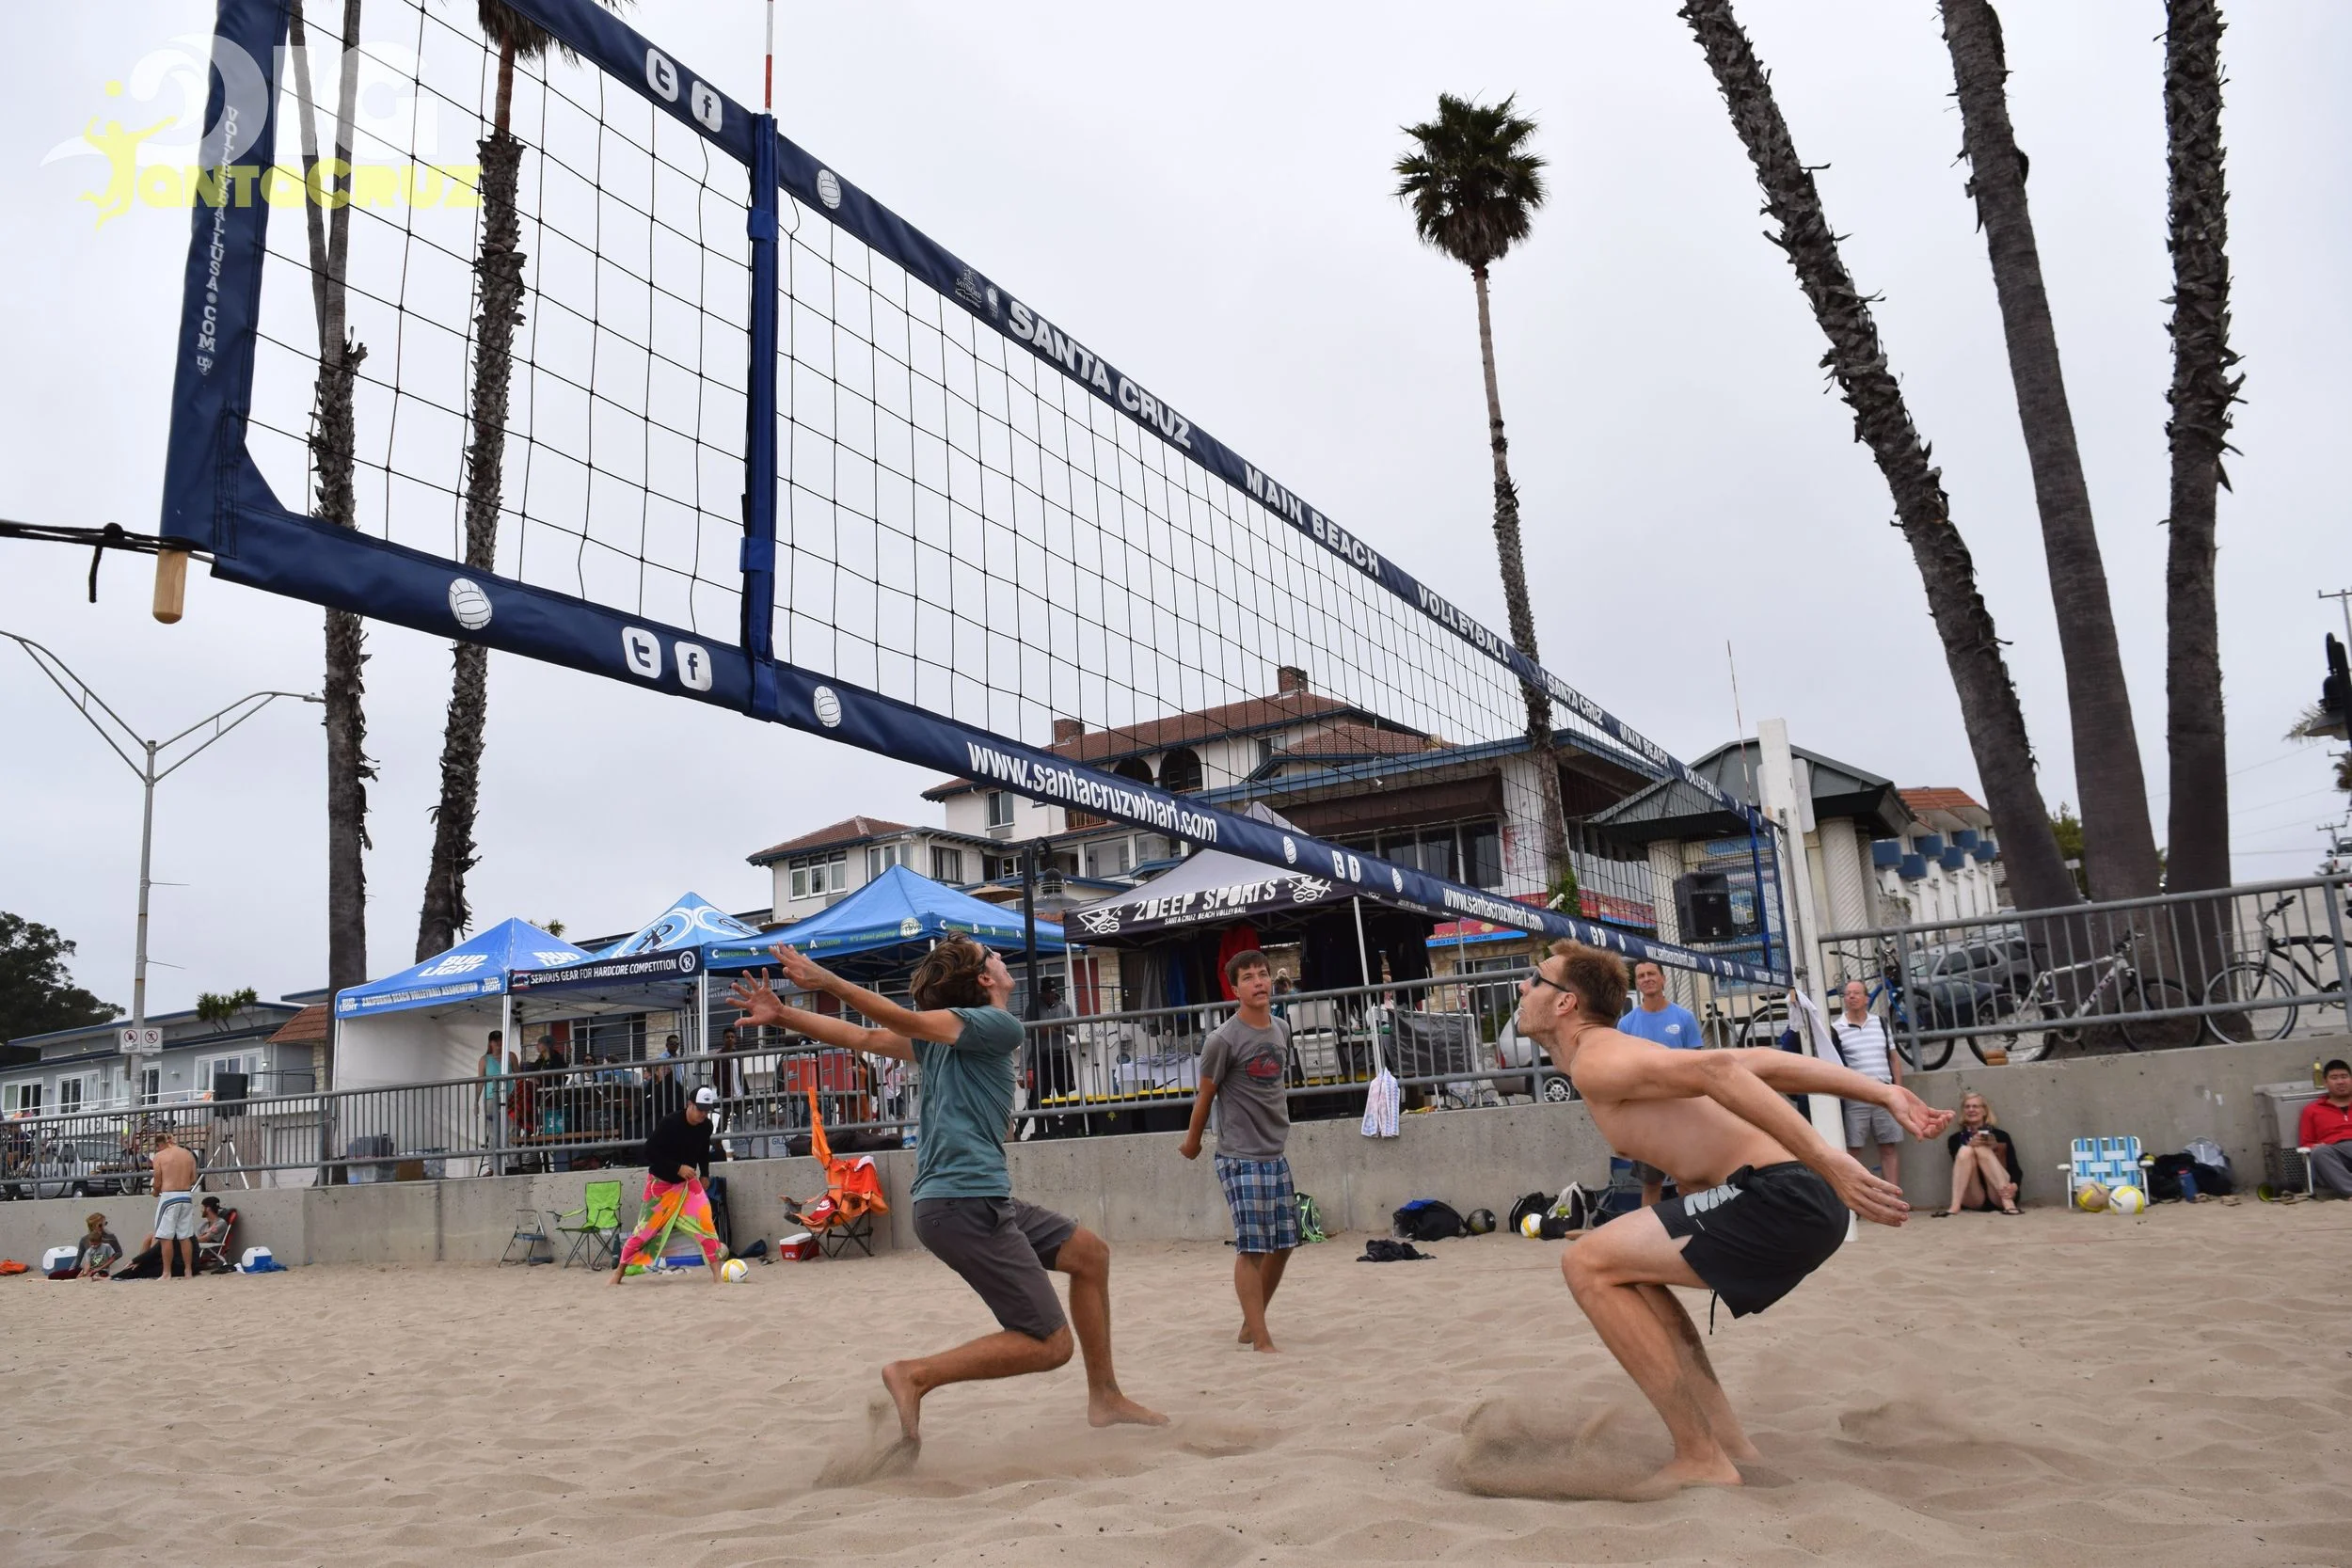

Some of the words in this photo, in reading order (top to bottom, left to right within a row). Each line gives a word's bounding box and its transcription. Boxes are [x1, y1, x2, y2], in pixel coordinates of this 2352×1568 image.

[1009, 301, 1112, 396] SANTA
[1118, 376, 1191, 450] CRUZ
[1245, 464, 1304, 526] MAIN
[1311, 510, 1380, 578] BEACH
[1417, 582, 1511, 664] VOLLEYBALL
[1547, 674, 1579, 709] SANTA
[1579, 693, 1604, 725] CRUZ
[1618, 722, 1642, 752] MAIN
[1644, 738, 1669, 768] BEACH
[967, 741, 1217, 843] www.santacruzwharf.com
[1133, 895, 1196, 922] 2DEEP
[1202, 879, 1279, 910] SPORTS
[1164, 916, 1182, 926] SANTA
[1182, 913, 1196, 923] CRUZ
[1198, 911, 1216, 920] BEACH
[1216, 905, 1247, 917] VOLLEYBALL
[418, 962, 485, 977] LIGHT
[439, 954, 489, 967] BUD
[530, 972, 561, 985] SERIOUS
[560, 969, 580, 981] GEAR
[580, 968, 593, 979] FOR
[593, 963, 629, 978] HARDCORE
[629, 958, 677, 974] COMPETITION
[410, 987, 441, 1001] VOLLEYBALL
[440, 981, 479, 996] ASSOCIATION
[482, 983, 501, 992] LIGHT
[339, 1003, 358, 1013] LIGHT
